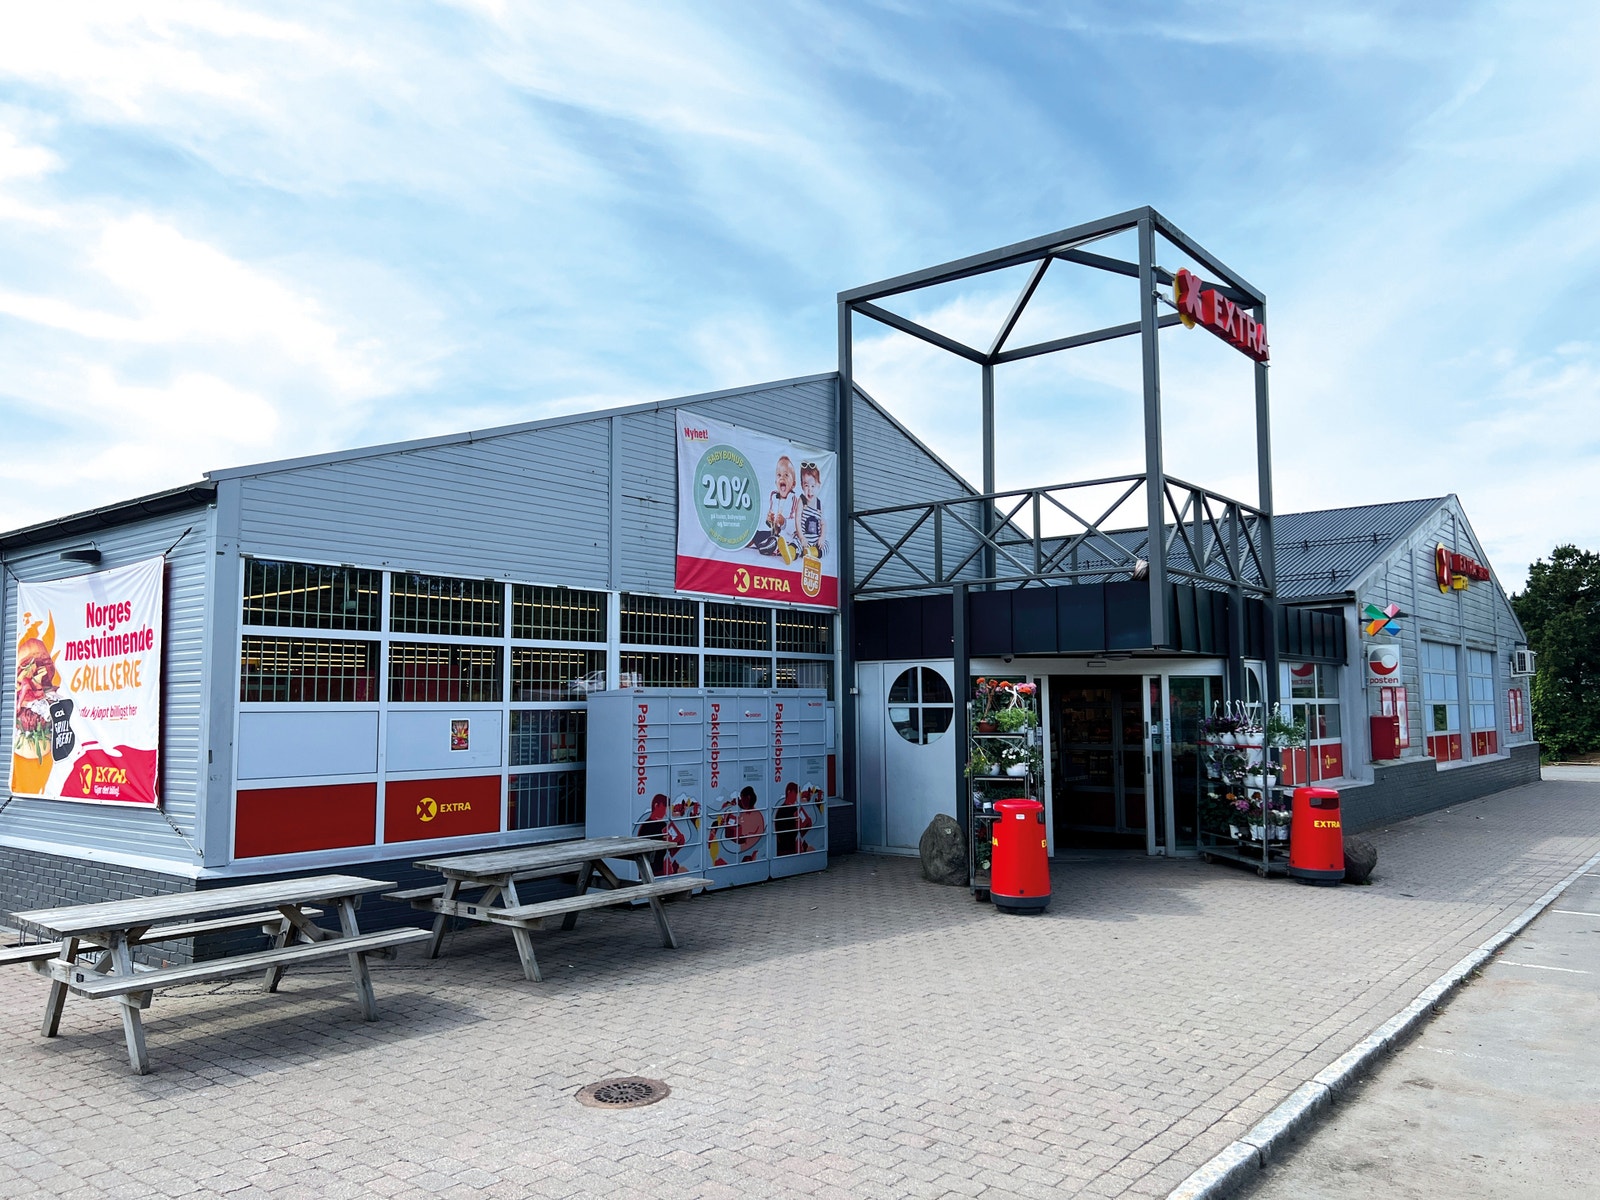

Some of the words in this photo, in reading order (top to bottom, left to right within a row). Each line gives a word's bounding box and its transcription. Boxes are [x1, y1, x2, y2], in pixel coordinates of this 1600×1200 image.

[1205, 289, 1270, 361] EXTRA
[684, 427, 708, 440] Nyhet!
[706, 450, 744, 468] BABYBONUS
[702, 474, 751, 509] 20%
[753, 576, 791, 593] EXTRA
[804, 568, 819, 580] Extra
[86, 600, 131, 631] Norges
[65, 623, 153, 661] mestvinnende
[70, 658, 142, 693] GRILLSERIE
[1369, 676, 1399, 684] posten
[637, 704, 648, 795] Pakkeboks
[711, 703, 720, 788] Pakkeboks
[775, 703, 783, 783] Pakkeboks
[94, 766, 127, 784] EXTRA
[440, 801, 471, 813] EXTRA
[1313, 820, 1341, 828] EXTRA
